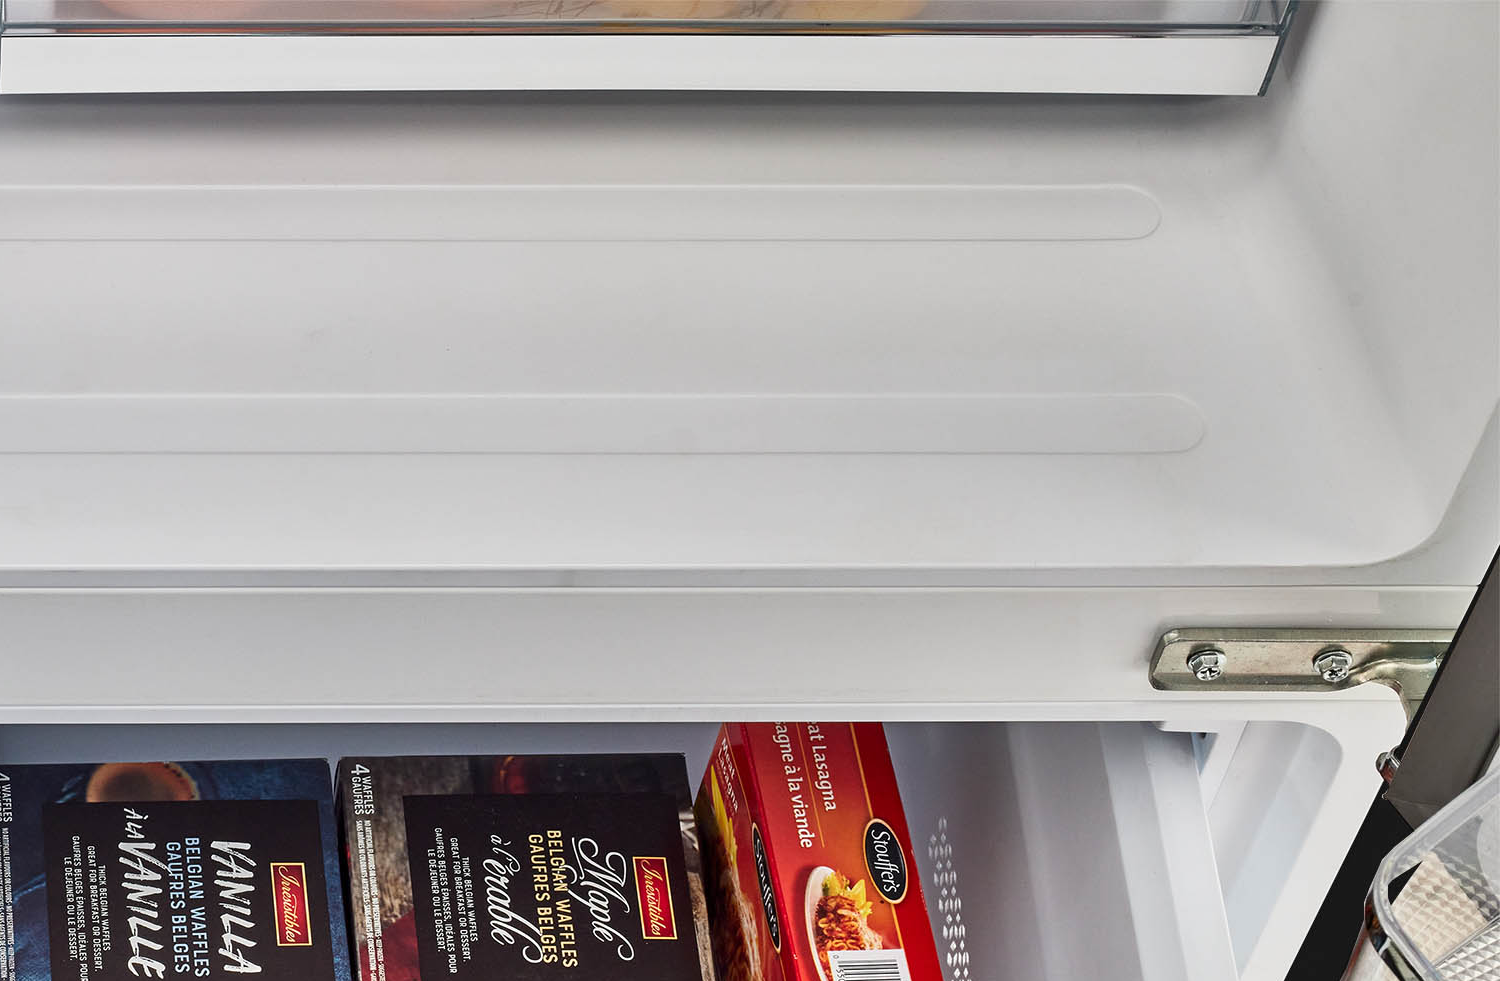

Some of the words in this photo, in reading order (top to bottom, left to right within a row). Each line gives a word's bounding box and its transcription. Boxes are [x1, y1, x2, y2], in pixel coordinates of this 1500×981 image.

[772, 722, 794, 762] agne
[807, 722, 825, 742] at
[350, 763, 371, 776] 4
[783, 764, 801, 776] à
[787, 777, 805, 793] la
[811, 745, 838, 812] Lasagna
[1, 784, 13, 823] WAFFLES
[352, 776, 365, 816] GAUFRES
[362, 775, 375, 815] WAFFLES
[789, 794, 816, 850] viande
[72, 835, 82, 867] GAUFRES
[87, 845, 97, 867] GREAT
[427, 849, 435, 857] LE
[434, 827, 445, 858] GAUFRES
[450, 837, 460, 859] GREAT
[64, 857, 72, 865] LE
[89, 869, 97, 883] FOR
[98, 865, 107, 886] THICK
[166, 841, 186, 910] GAUFRES
[185, 837, 205, 900] BELGIAN
[437, 860, 448, 886] BELGES
[452, 861, 461, 874] FOR
[462, 857, 471, 877] THICK
[528, 834, 550, 902] GAUFRES
[547, 830, 571, 892] BELGIAN
[871, 829, 900, 894] Stouffer's
[74, 868, 84, 894] BELGES
[454, 876, 465, 915] BREAKFAST
[463, 879, 474, 908] BELGIAN
[754, 837, 779, 939] Stouffer's
[67, 904, 75, 915] OU
[89, 885, 100, 924] BREAKFAST
[99, 887, 108, 917] BELGIAN
[118, 842, 173, 979] VANILLE
[210, 840, 262, 974] VANILLA
[280, 864, 302, 944] Irresistibles
[432, 896, 441, 907] OU
[433, 908, 442, 917] LE
[560, 837, 634, 961] Maple
[641, 859, 667, 937] Irresistibles
[67, 917, 76, 926] LE
[92, 926, 100, 937] OR
[101, 918, 111, 951] WAFFLES
[435, 919, 446, 953] DESSERT.
[458, 917, 467, 927] OR
[467, 910, 478, 942] WAFFLES
[536, 907, 559, 964] BELGES
[556, 898, 580, 969] WAFFLES
[68, 928, 78, 961] DESSERT.
[93, 938, 103, 972] DESSERT.
[171, 915, 191, 974] BELGES
[190, 906, 211, 978] WAFFLES
[460, 930, 471, 963] DESSERT.
[448, 954, 457, 974] POUR
